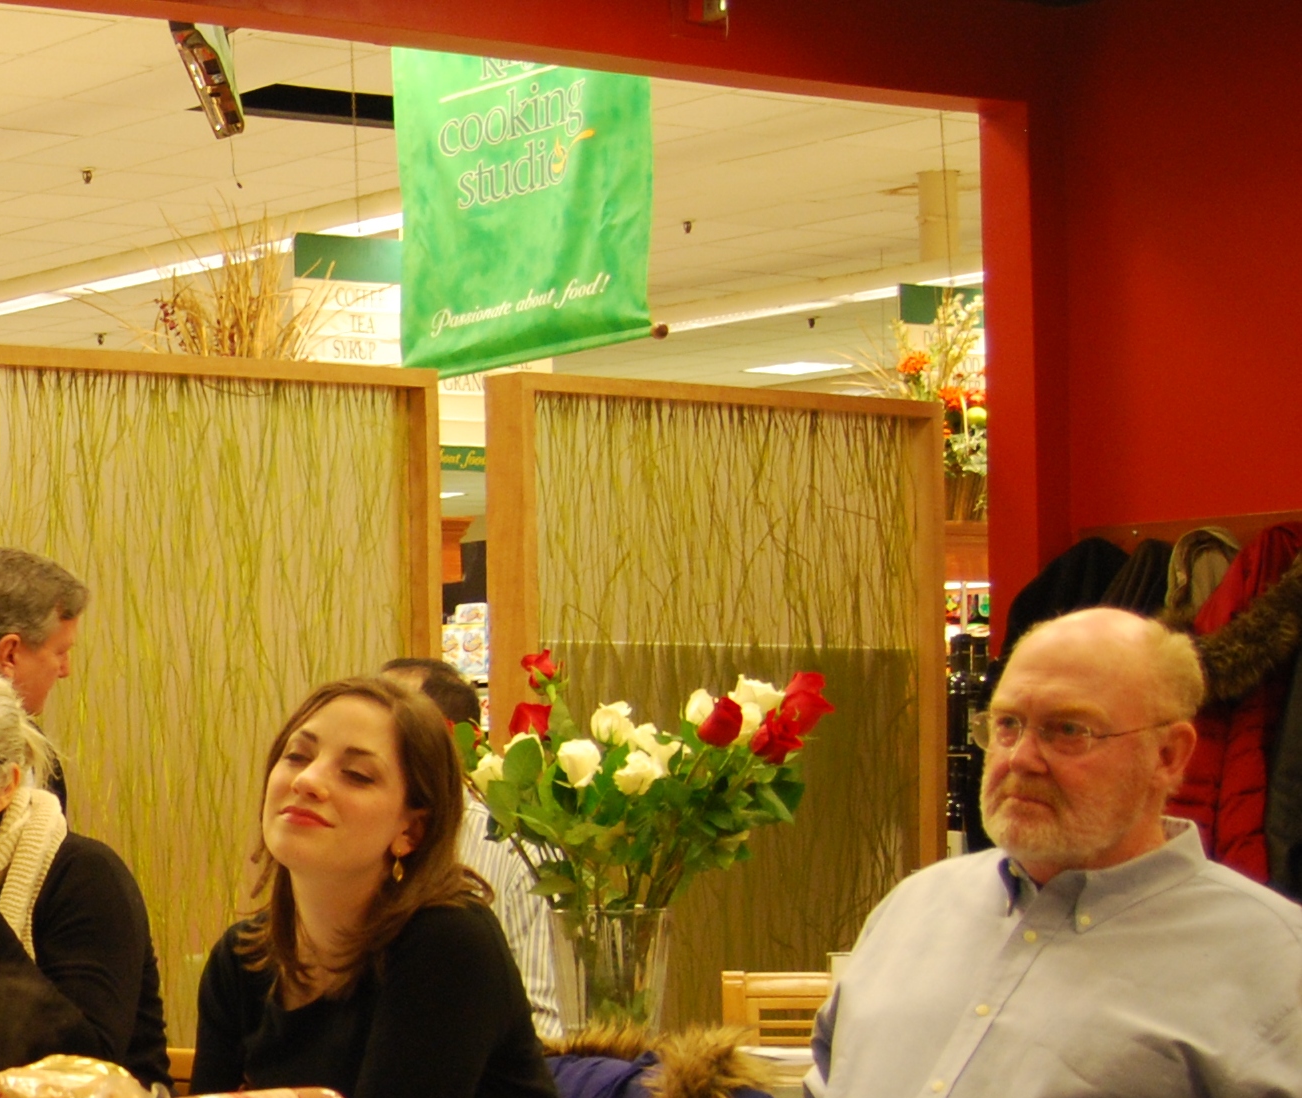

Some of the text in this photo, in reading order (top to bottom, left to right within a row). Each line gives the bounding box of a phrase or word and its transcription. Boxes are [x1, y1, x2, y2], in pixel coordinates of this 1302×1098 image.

[439, 78, 586, 157] cooking
[458, 138, 567, 209] studio
[350, 314, 375, 334] TEA
[430, 271, 611, 338] Passionate about food!
